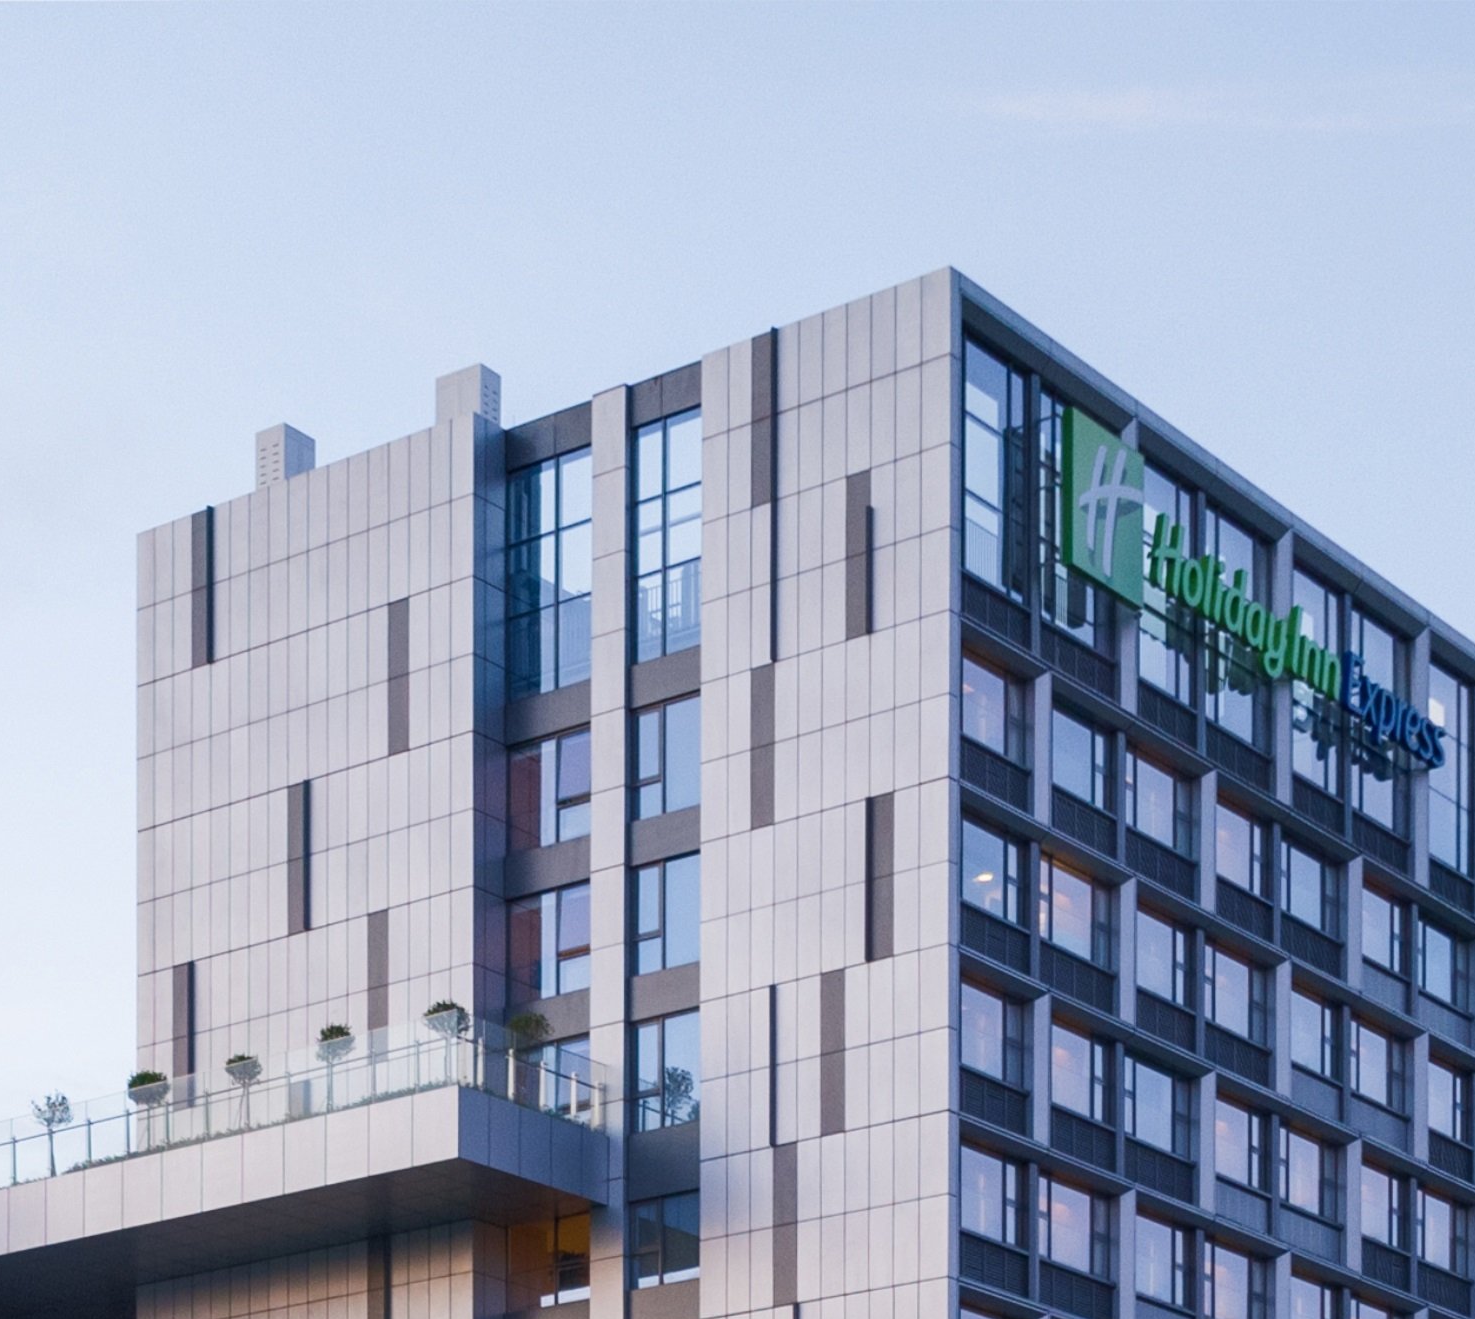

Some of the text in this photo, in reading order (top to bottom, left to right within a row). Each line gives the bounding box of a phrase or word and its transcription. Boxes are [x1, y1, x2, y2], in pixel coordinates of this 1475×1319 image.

[1148, 512, 1447, 769] Holiday Inn Express
